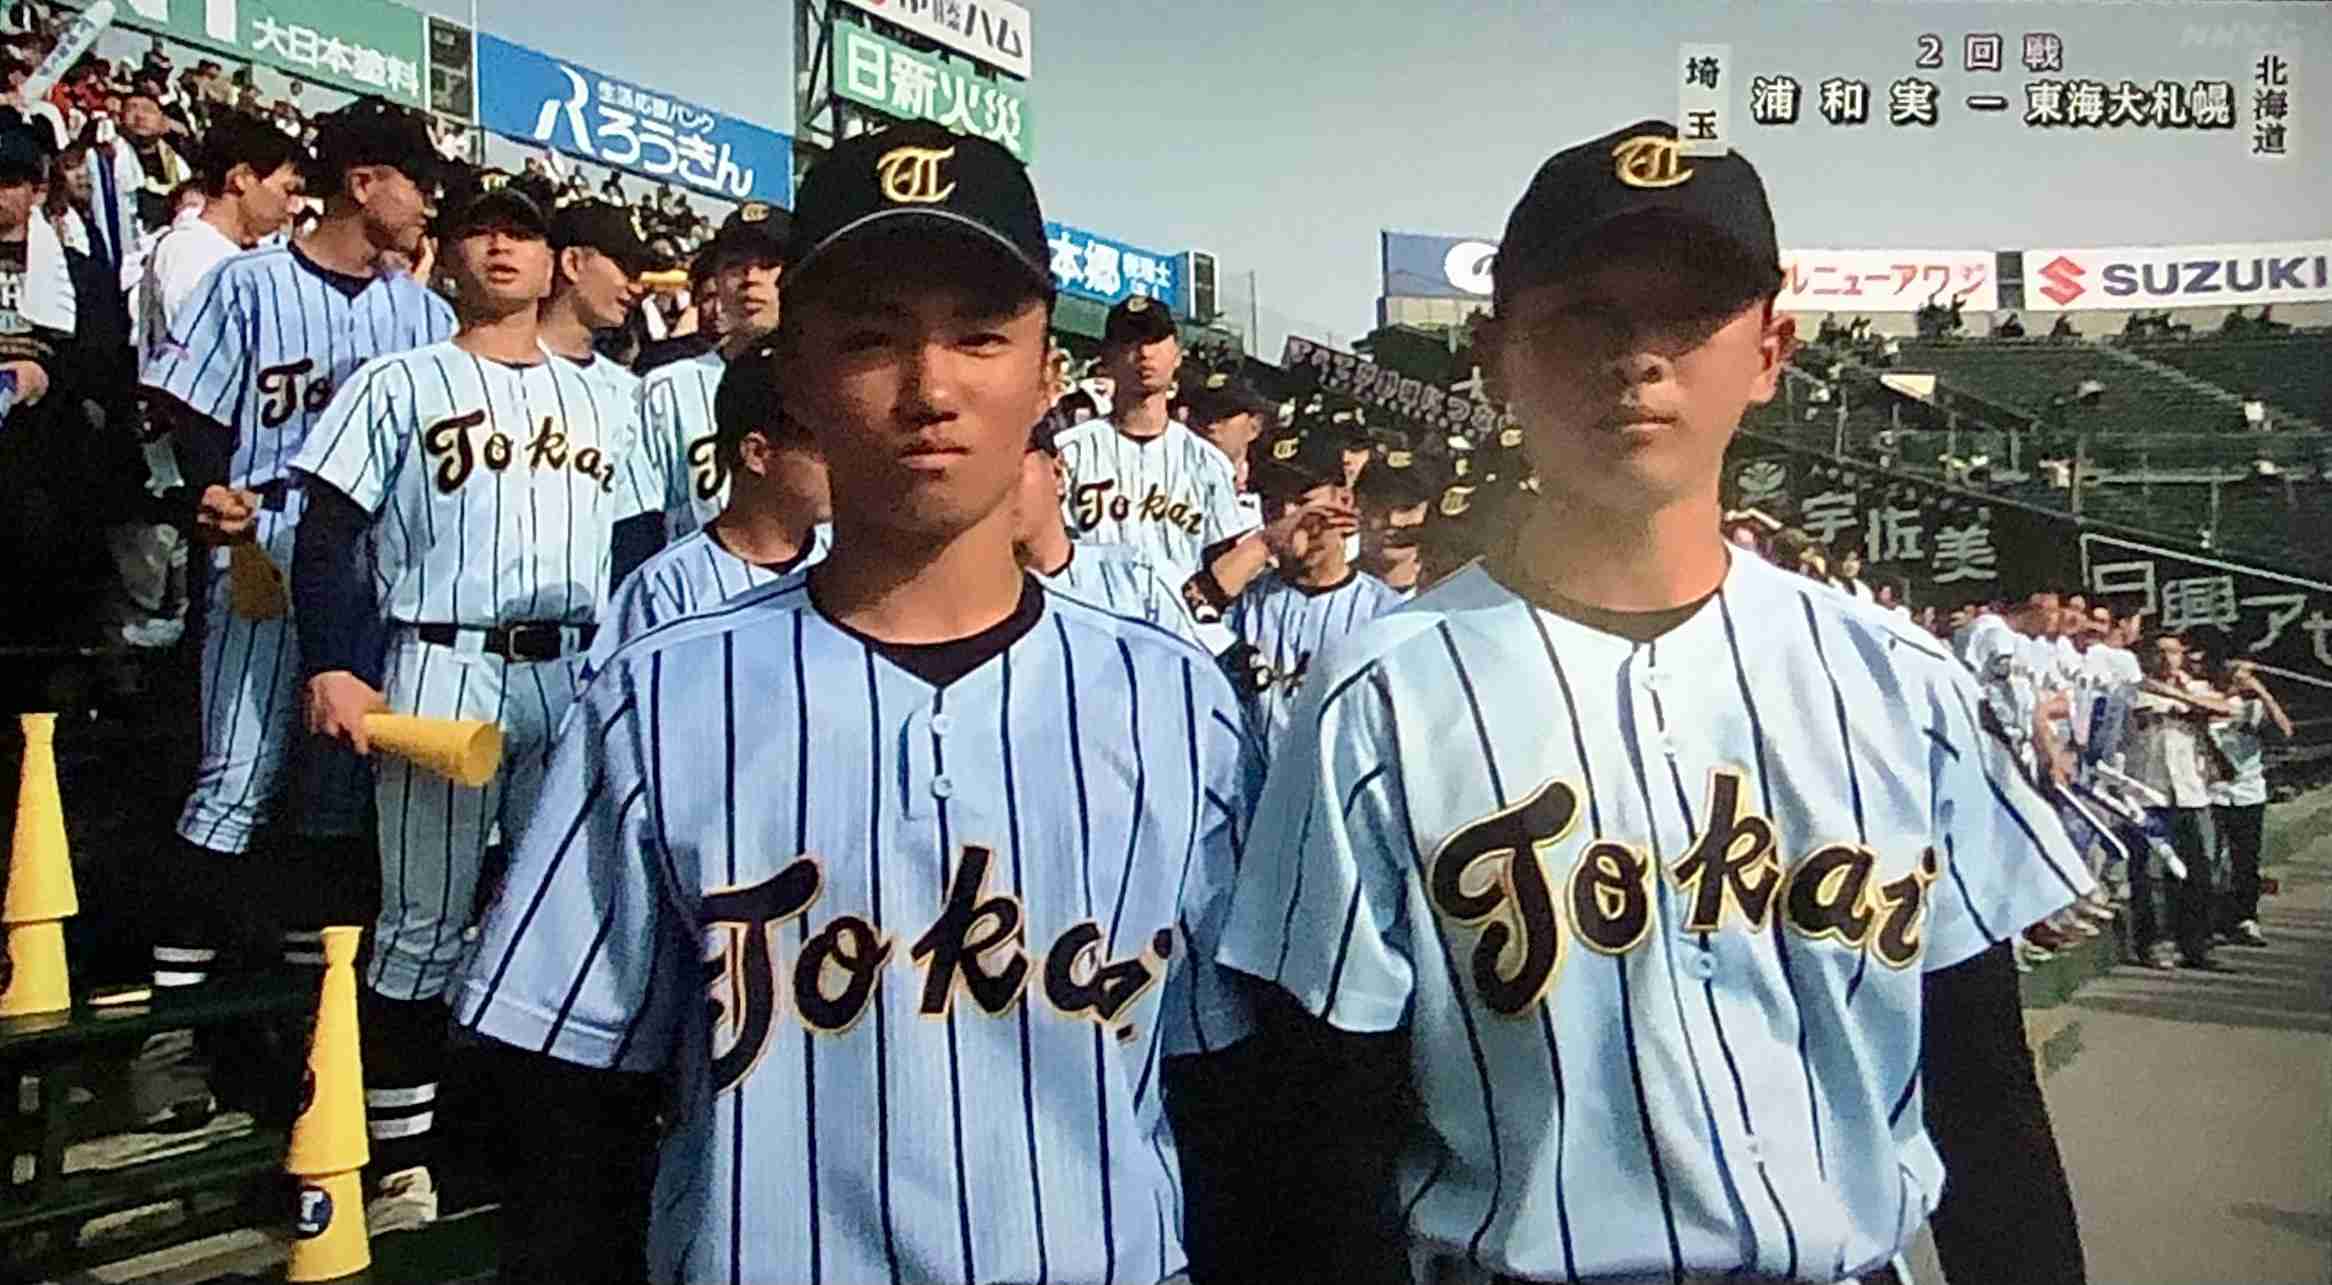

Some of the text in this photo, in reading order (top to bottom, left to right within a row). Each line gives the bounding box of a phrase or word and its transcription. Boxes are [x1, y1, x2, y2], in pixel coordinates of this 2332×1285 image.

[848, 30, 1022, 158] 日新火災
[597, 102, 754, 197] ろうきん
[2102, 255, 2328, 297] SUZUKI
[1800, 492, 1999, 584] 宇佐美
[1429, 764, 1938, 1014] Tokai
